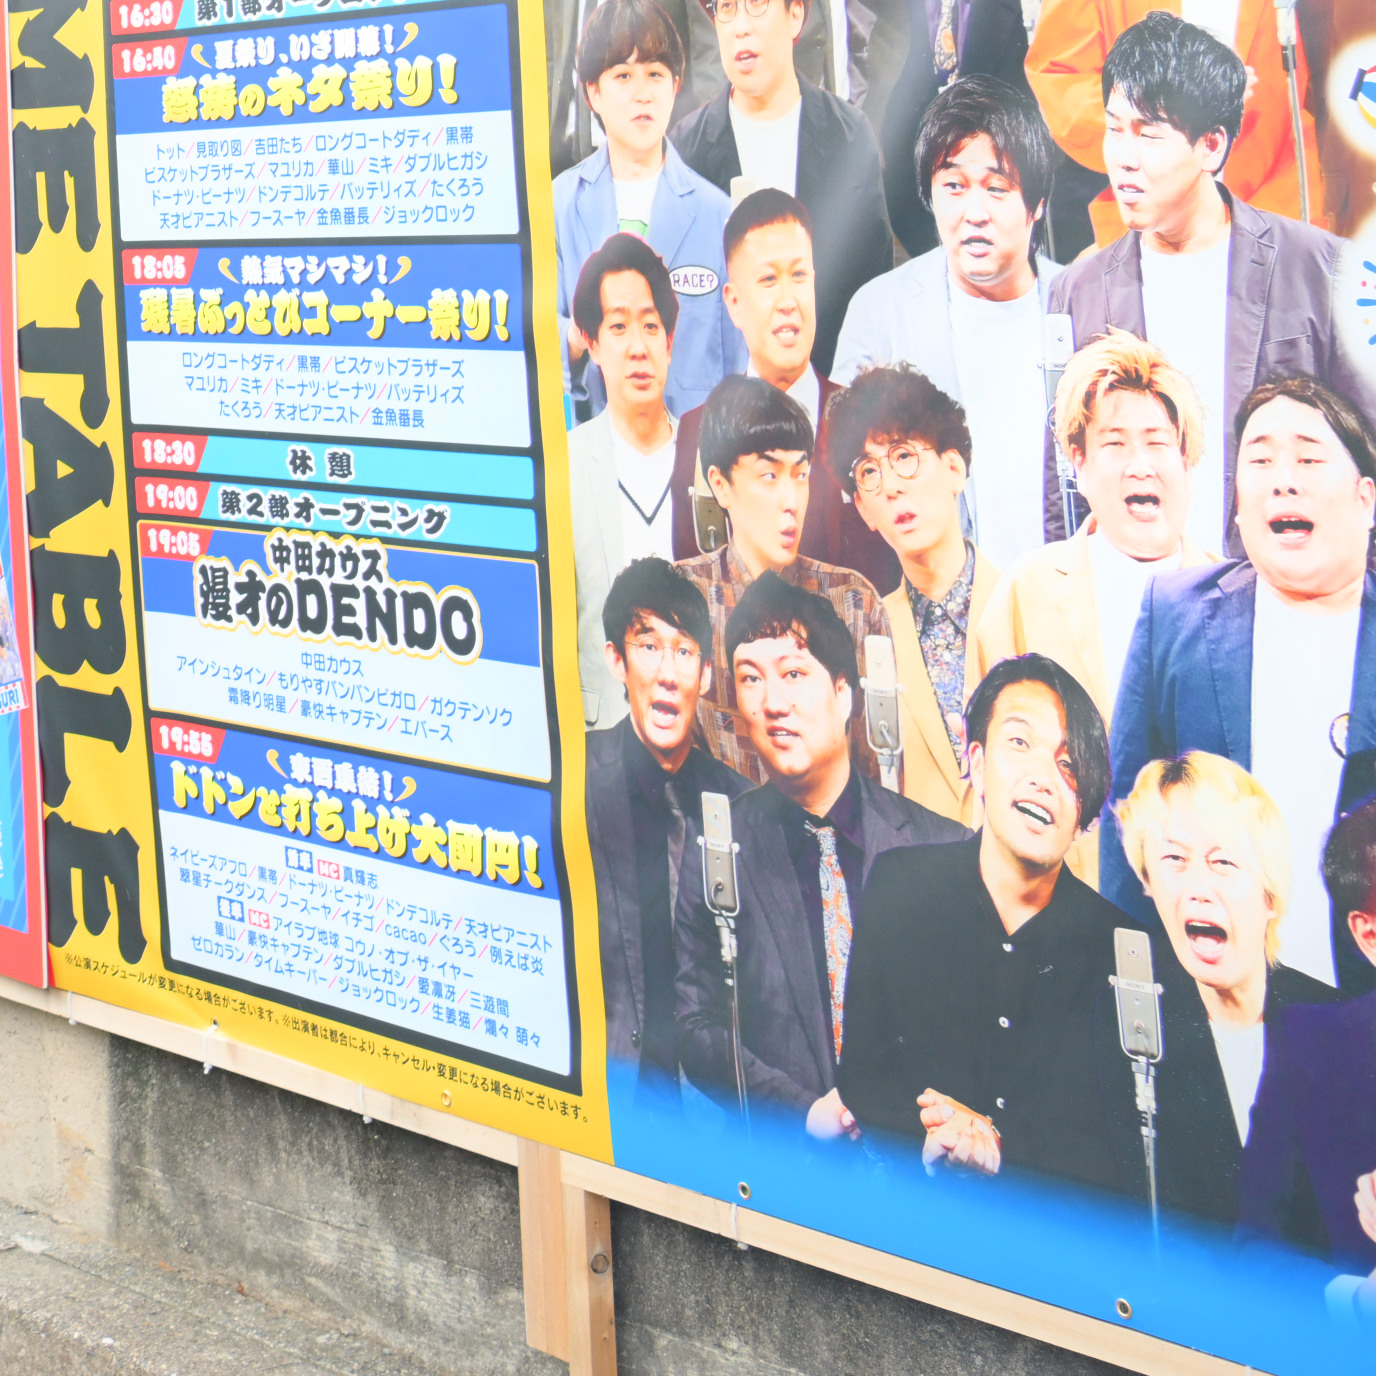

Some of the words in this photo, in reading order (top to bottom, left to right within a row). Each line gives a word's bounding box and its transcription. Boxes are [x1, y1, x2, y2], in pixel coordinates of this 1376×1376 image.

[119, 0, 174, 28] 16:30
[121, 45, 176, 72] 16:40
[131, 255, 186, 280] 18:05
[142, 439, 195, 466] 18:30
[145, 485, 198, 511] 19:00
[221, 488, 449, 536] 第2部オープニング
[148, 528, 201, 556] 19:05
[270, 538, 384, 582] 中田カウス
[199, 564, 477, 657] 漫才のDENDO
[301, 651, 365, 678] 中田カウス
[159, 725, 213, 758] 19:55
